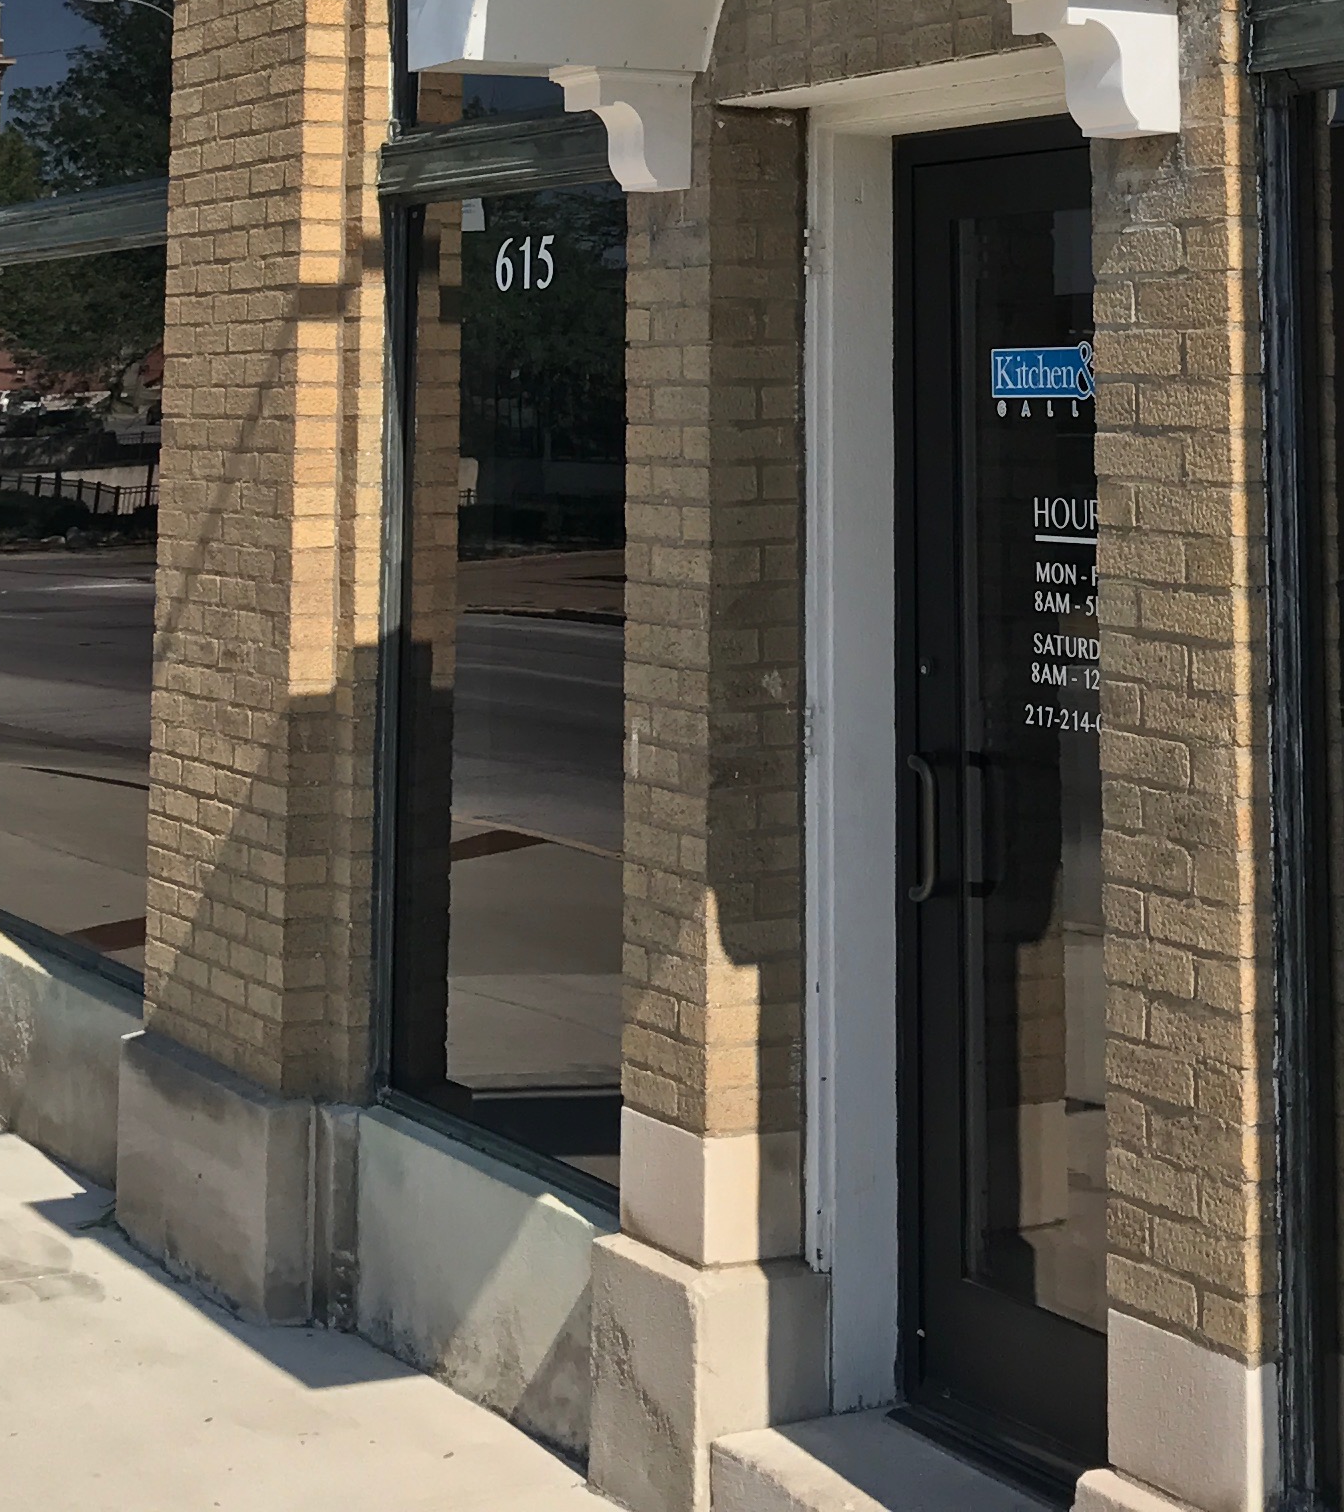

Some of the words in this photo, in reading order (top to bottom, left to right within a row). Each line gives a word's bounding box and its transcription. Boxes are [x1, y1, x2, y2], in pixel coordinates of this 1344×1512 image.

[495, 234, 555, 292] 615
[995, 353, 1076, 390] Kitchen
[996, 399, 1080, 418] GALL
[1033, 496, 1098, 530] HOUR
[1036, 561, 1077, 586] MON
[1034, 590, 1070, 614] 8AM
[1033, 632, 1101, 660] SATURD
[1031, 661, 1067, 687] 8AM
[1083, 668, 1100, 691] 12
[1024, 703, 1102, 736] 217-214-
